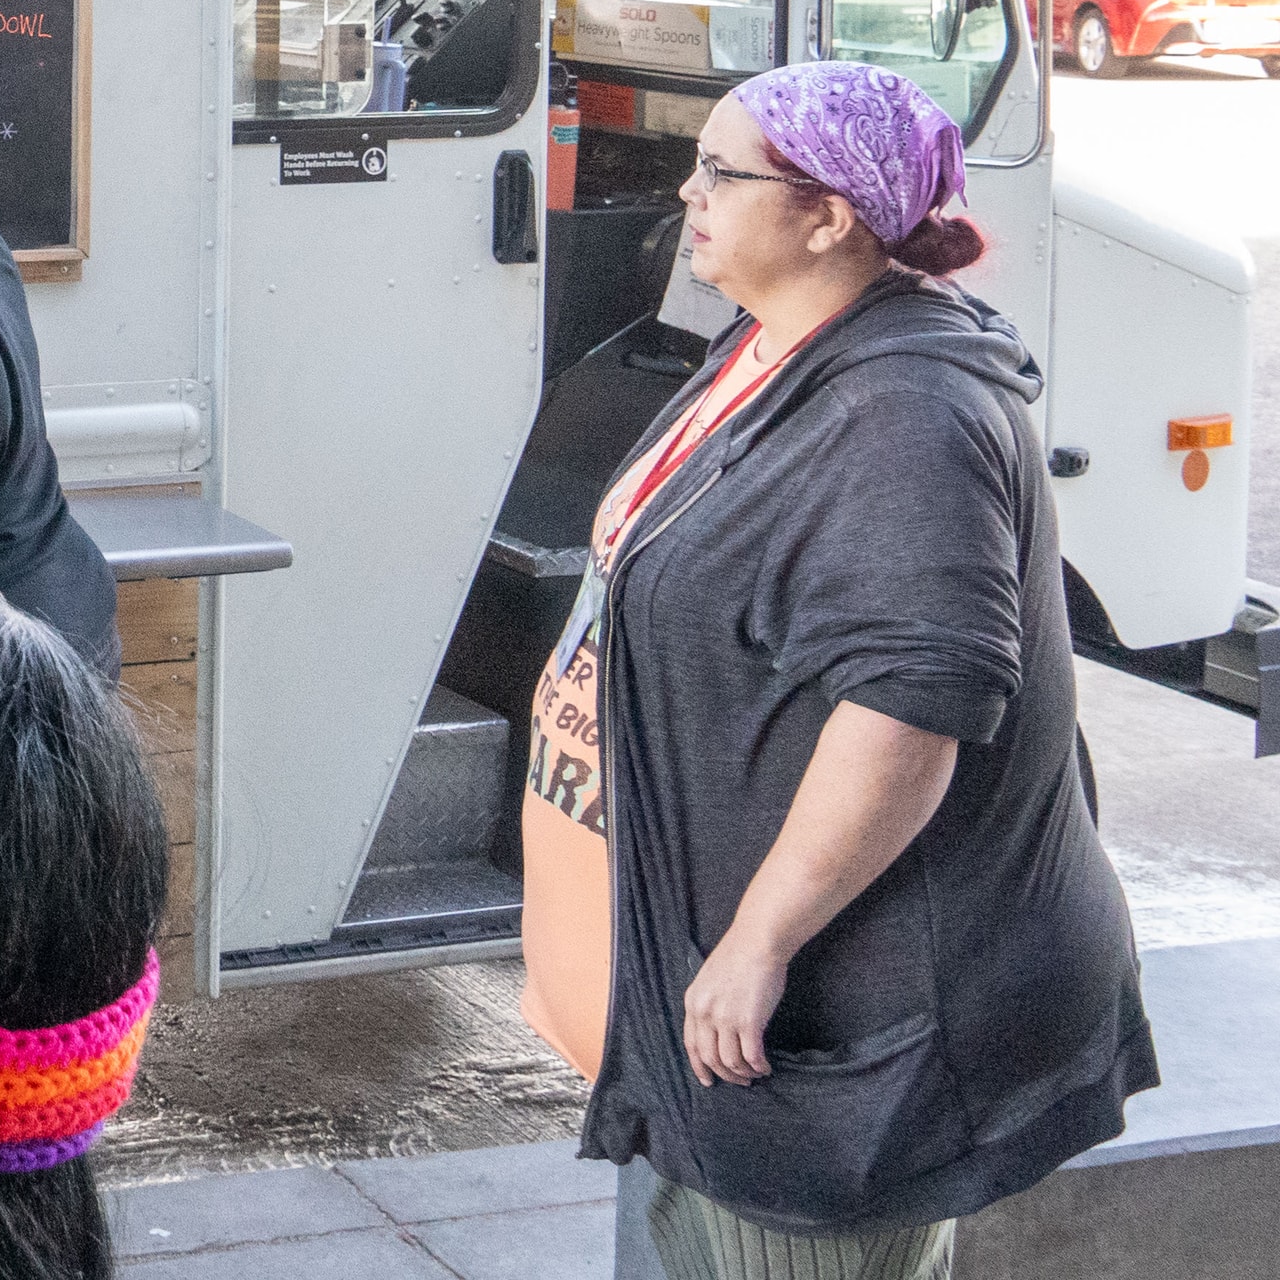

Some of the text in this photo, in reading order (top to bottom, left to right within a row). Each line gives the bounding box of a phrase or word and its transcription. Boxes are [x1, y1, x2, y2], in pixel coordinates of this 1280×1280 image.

[620, 7, 657, 22] SOLO
[577, 23, 650, 42] Heavywght
[654, 27, 701, 46] Spoons
[284, 153, 319, 162] Employees
[305, 160, 326, 168] Before
[327, 159, 360, 168] Returning
[293, 169, 311, 177] Work
[556, 702, 599, 747] BIG
